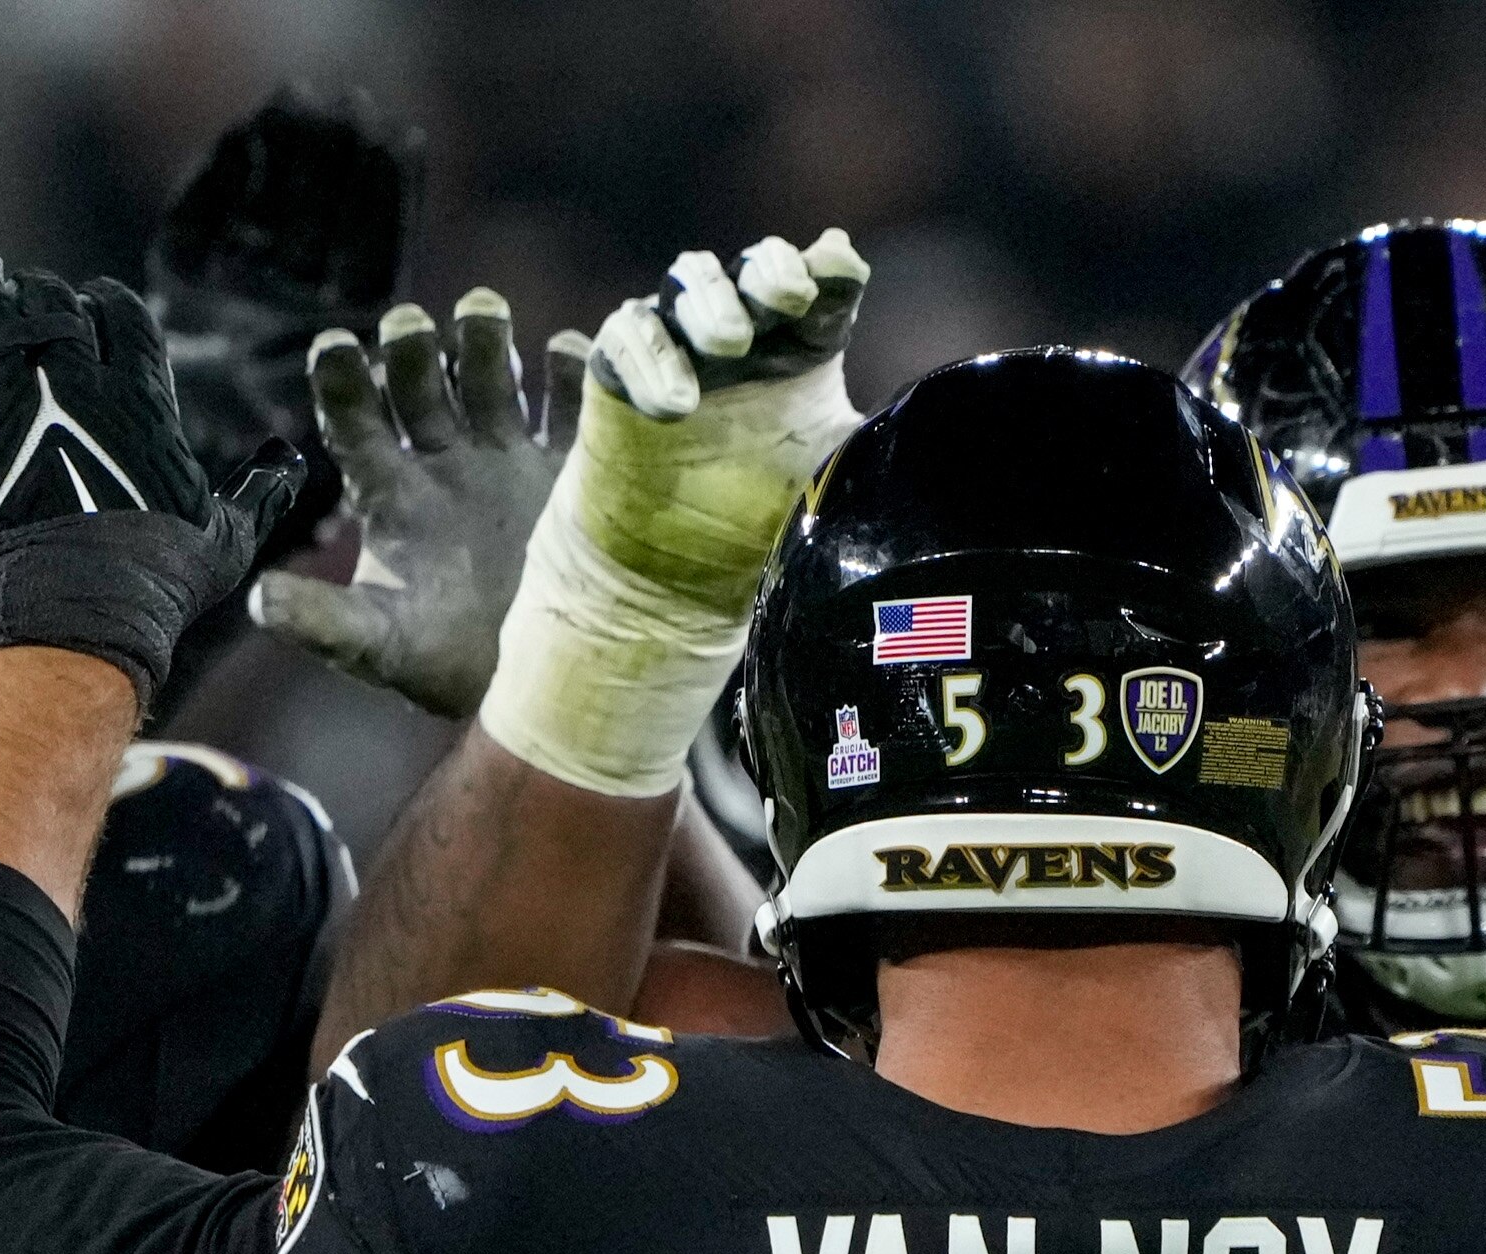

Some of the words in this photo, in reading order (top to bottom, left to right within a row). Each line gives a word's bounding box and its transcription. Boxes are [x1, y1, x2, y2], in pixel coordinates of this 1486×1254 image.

[1136, 680, 1168, 709] JOE
[1170, 681, 1188, 710] D.
[841, 720, 856, 737] NFL
[942, 674, 987, 766] 5
[1064, 674, 1107, 765] 3
[1136, 712, 1187, 735] JACOBY
[1228, 717, 1272, 726] WARNING
[835, 743, 868, 755] CRUCIAL
[1155, 736, 1167, 751] 12
[830, 751, 877, 776] CATCH
[830, 776, 855, 785] INTERCEPT
[857, 773, 878, 782] CANCER
[873, 842, 1177, 893] RAVENS
